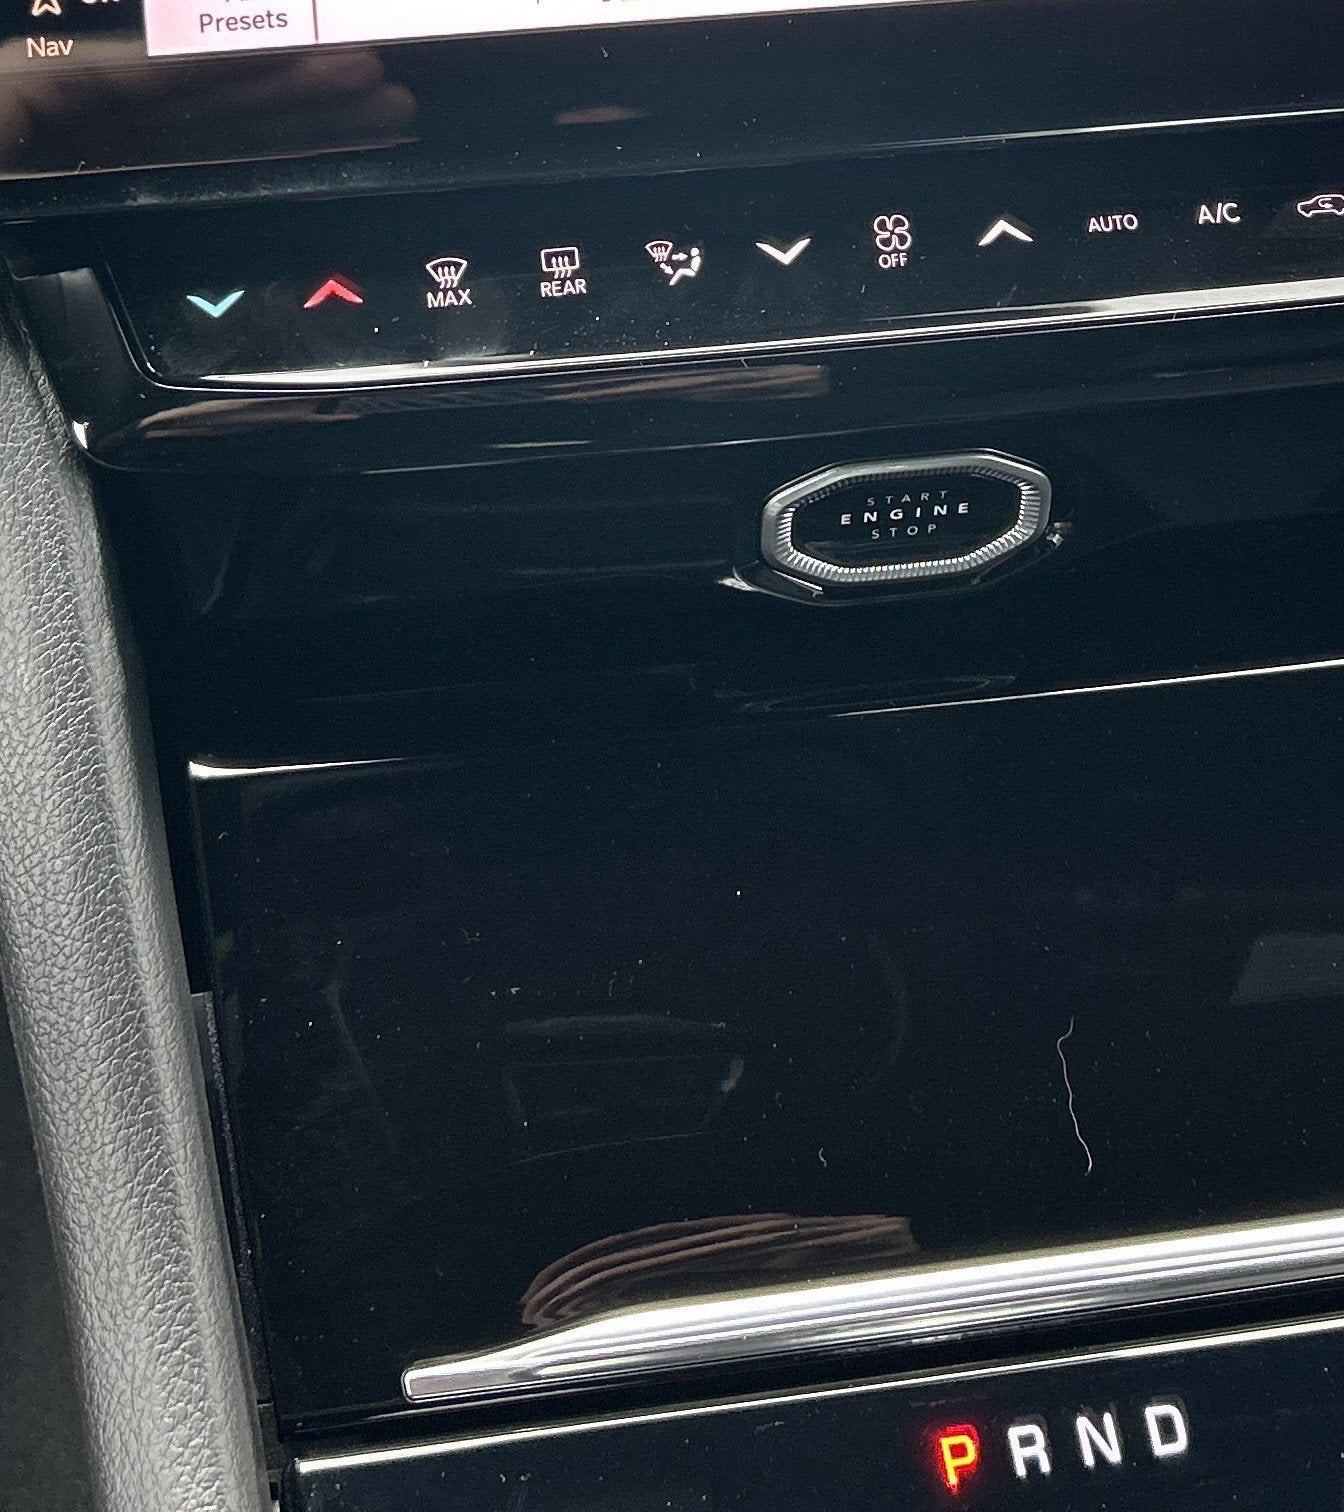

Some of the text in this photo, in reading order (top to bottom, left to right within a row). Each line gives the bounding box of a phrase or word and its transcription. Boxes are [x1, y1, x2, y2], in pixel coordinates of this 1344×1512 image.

[199, 9, 288, 34] Presets
[26, 36, 74, 59] Nav
[1088, 213, 1138, 234] AUTO
[1198, 202, 1241, 226] A/C
[878, 251, 908, 269] OFF
[426, 288, 472, 308] MAX
[540, 277, 587, 298] REAR
[867, 490, 948, 507] START
[840, 502, 969, 525] ENGINE
[871, 523, 937, 540] STOP
[938, 1403, 1188, 1488] P R N D
